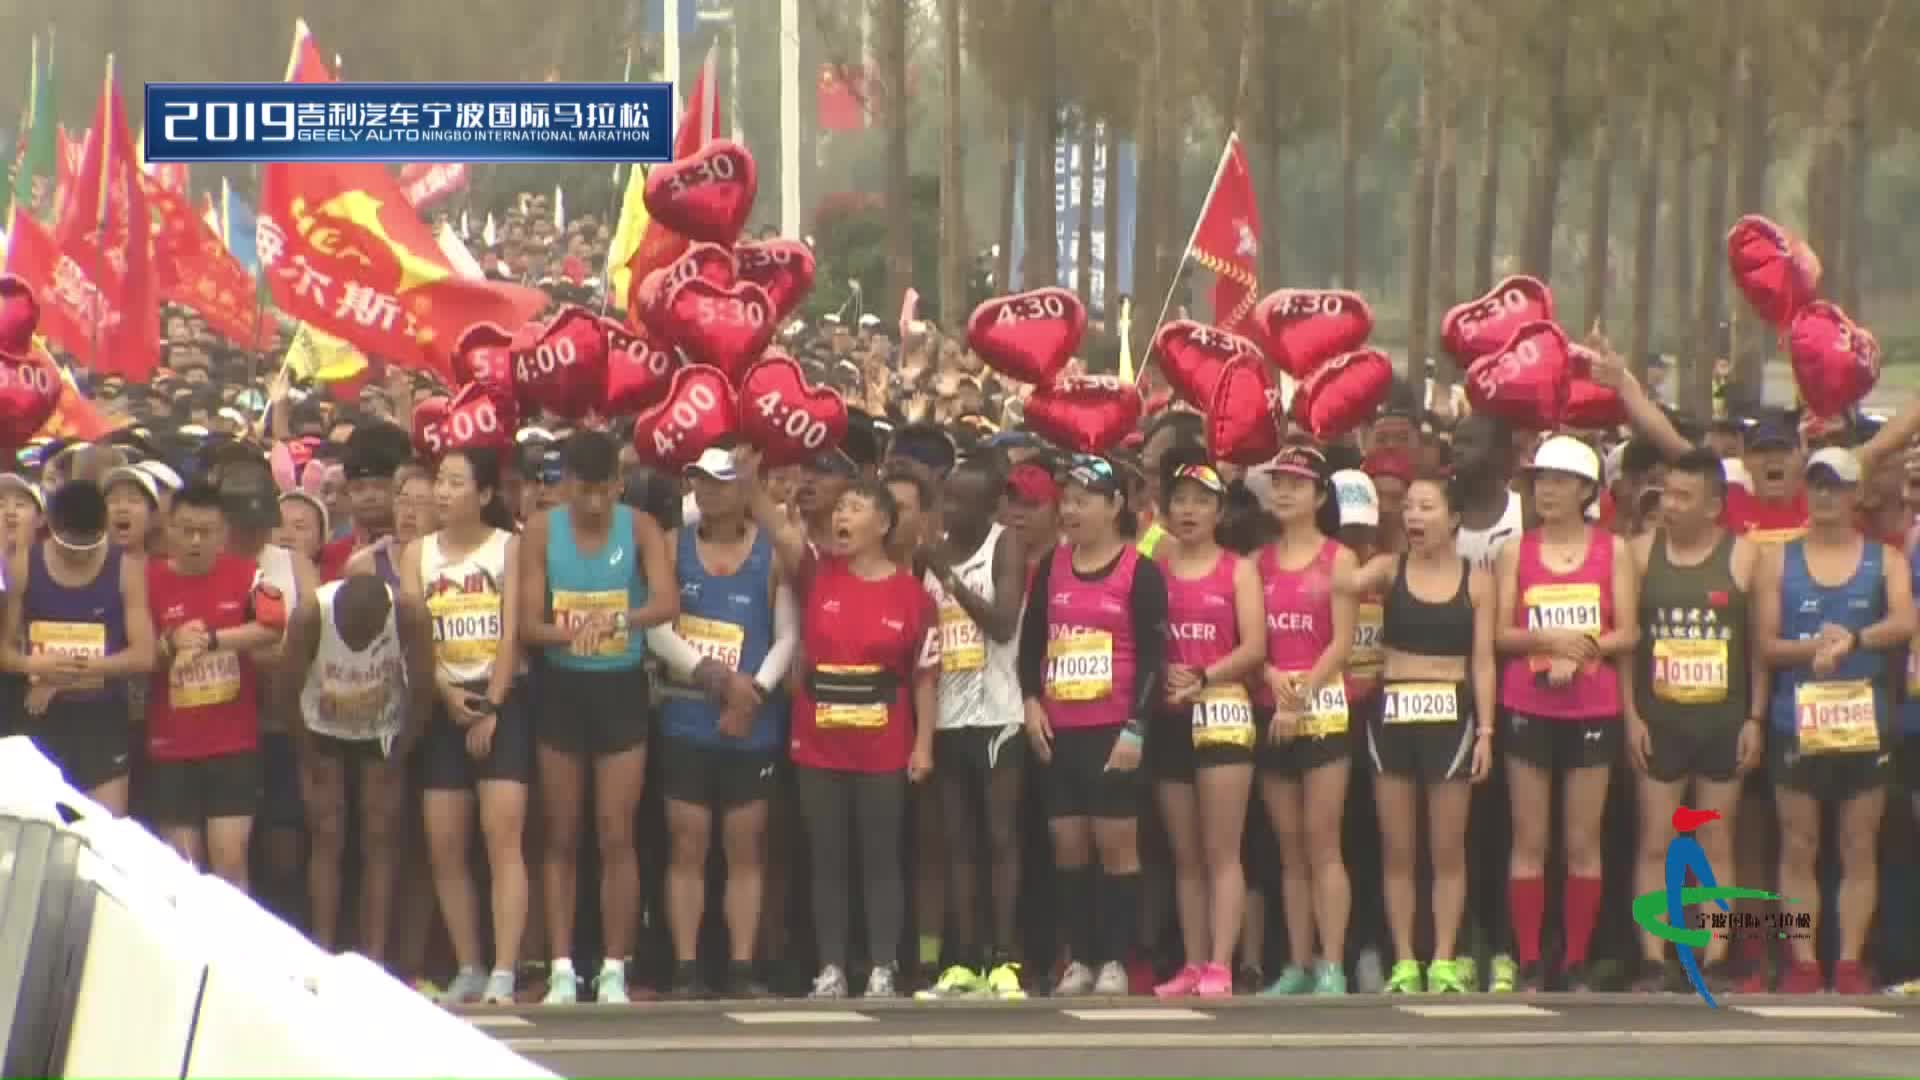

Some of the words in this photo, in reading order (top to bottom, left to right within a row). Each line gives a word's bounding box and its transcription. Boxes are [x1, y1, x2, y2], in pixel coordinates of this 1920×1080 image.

[668, 154, 735, 200] 3:30
[697, 297, 763, 330] 5:30
[996, 296, 1063, 328] 4:30
[1272, 296, 1342, 316] 4:30
[1457, 288, 1528, 342] 5:30
[516, 336, 576, 383] 4:00
[1477, 340, 1541, 400] 5:30
[423, 403, 497, 451] 5:00
[653, 383, 716, 456] 4:00
[756, 391, 827, 449] 4:00
